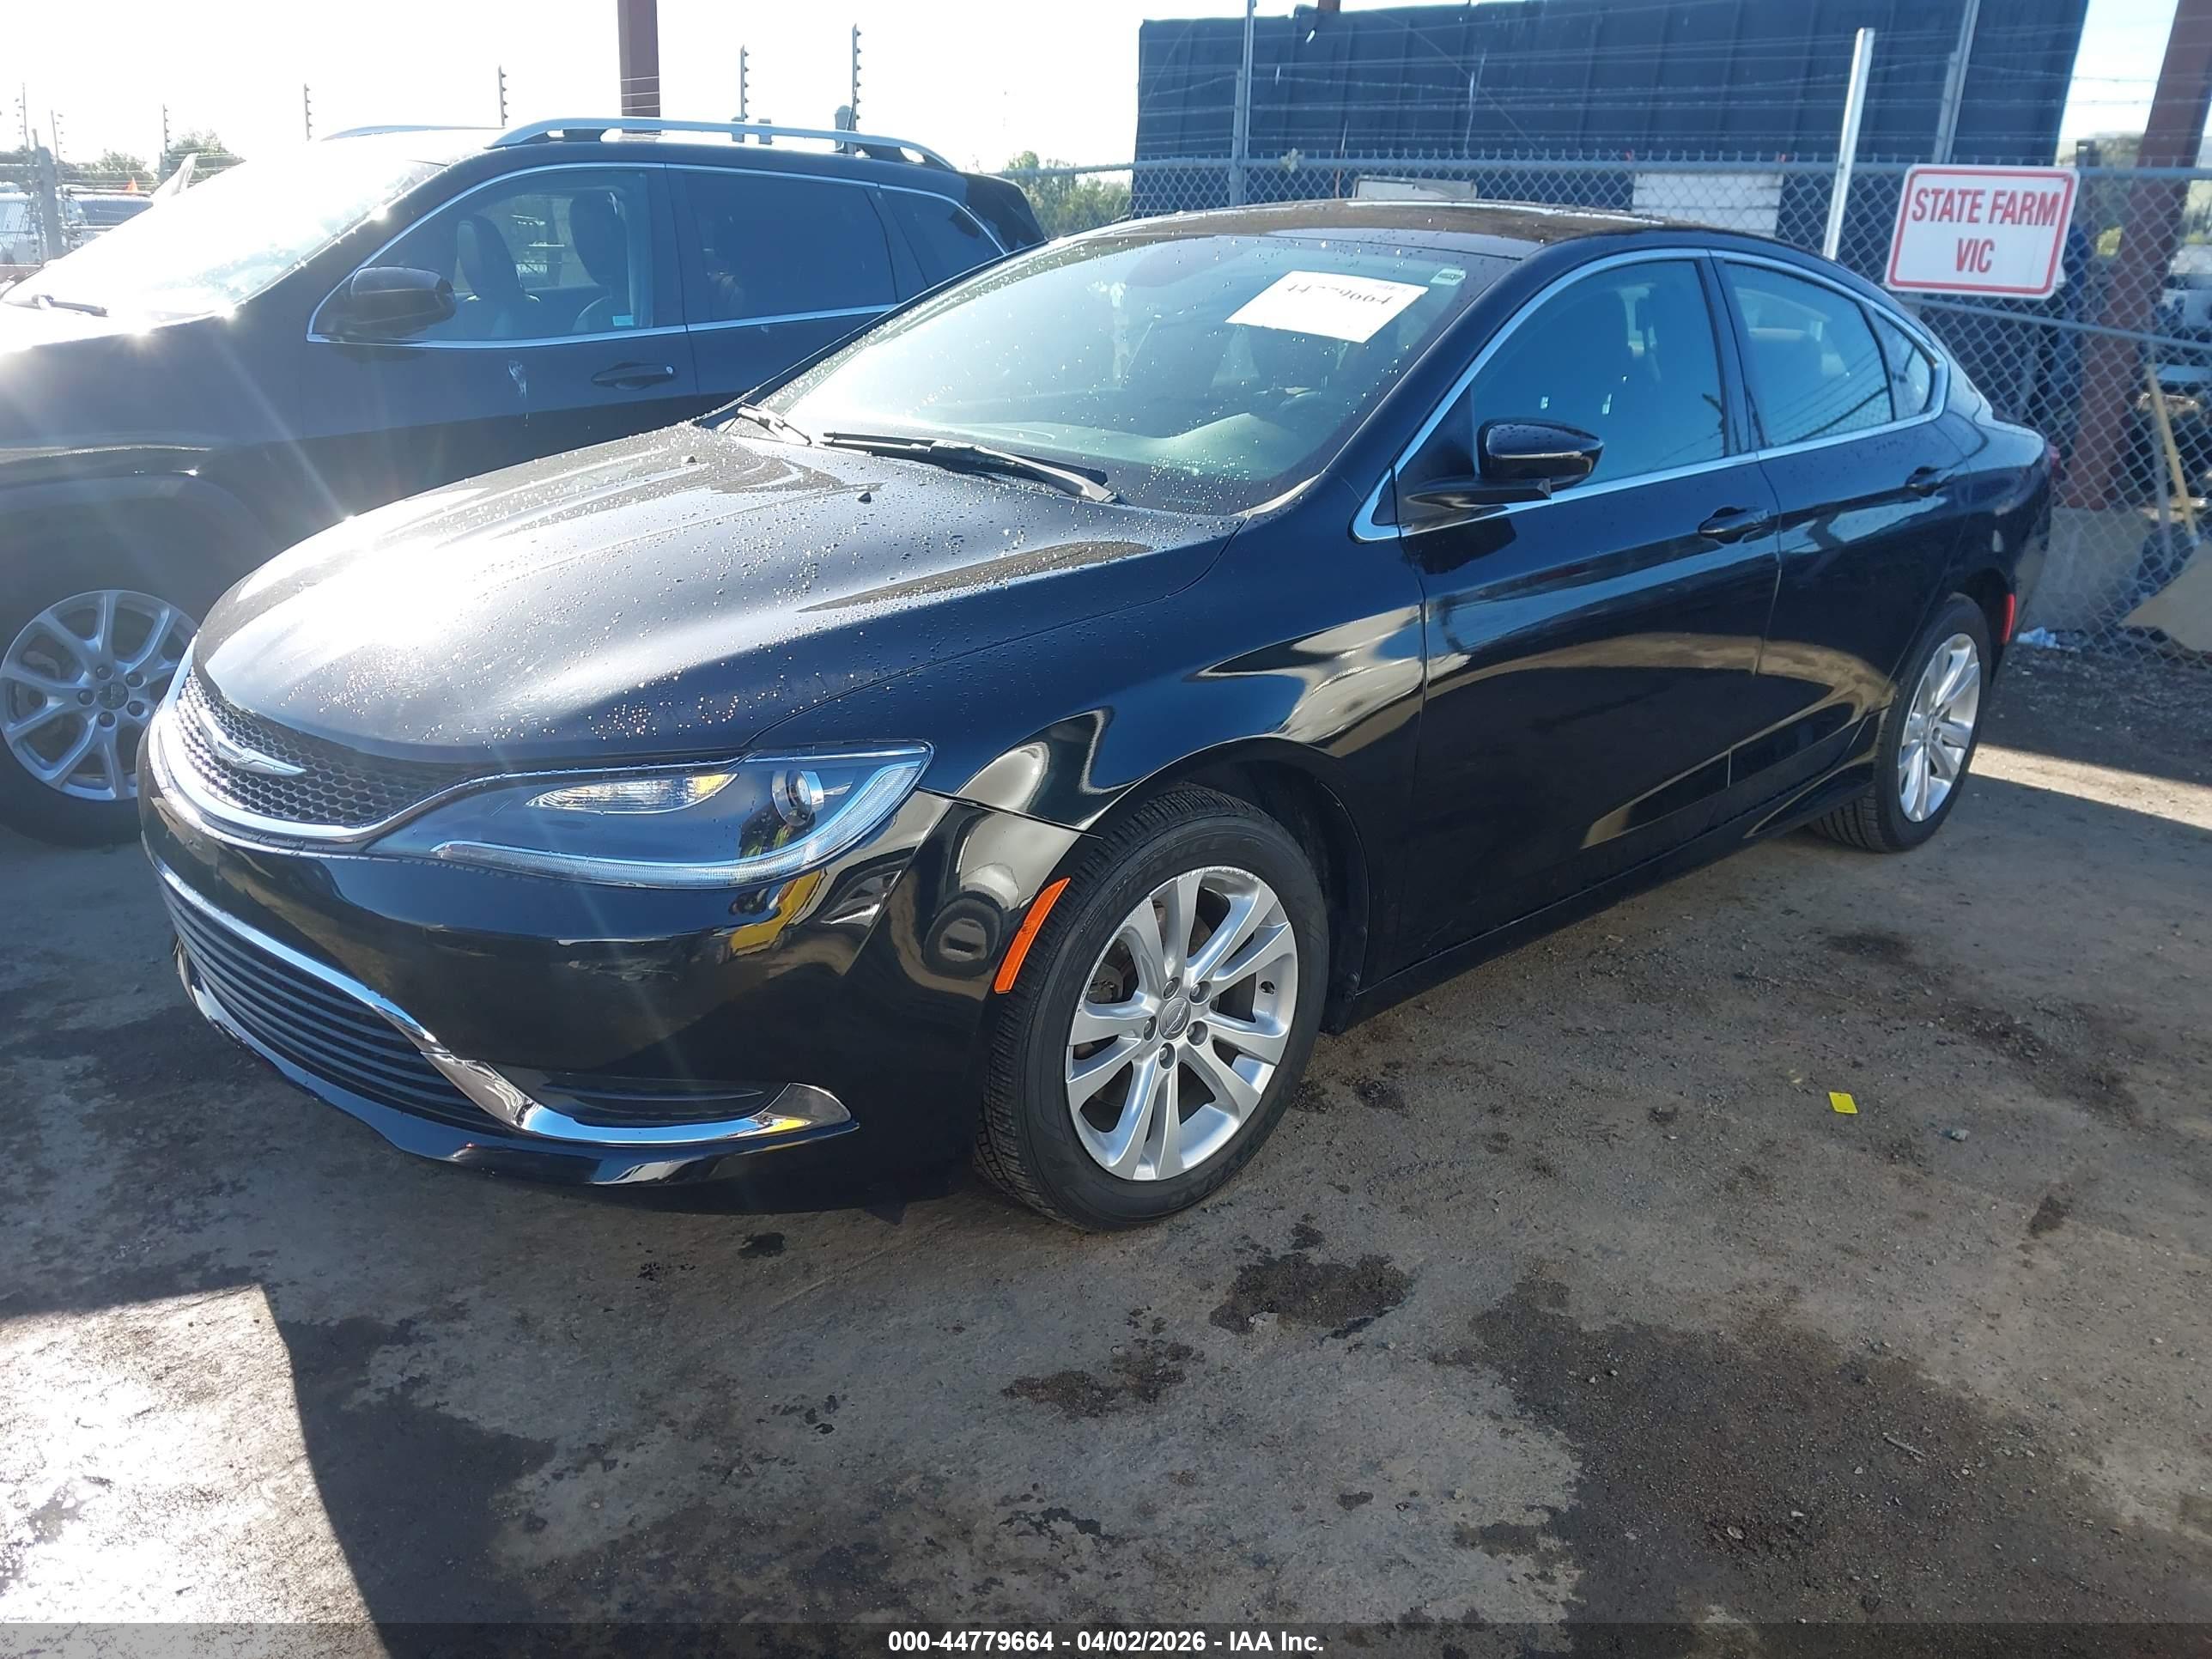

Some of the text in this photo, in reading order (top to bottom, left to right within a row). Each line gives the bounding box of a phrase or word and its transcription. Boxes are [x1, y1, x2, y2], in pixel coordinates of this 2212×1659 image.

[1911, 187, 2061, 227] STATE FARM
[1955, 237, 1996, 274] VIC
